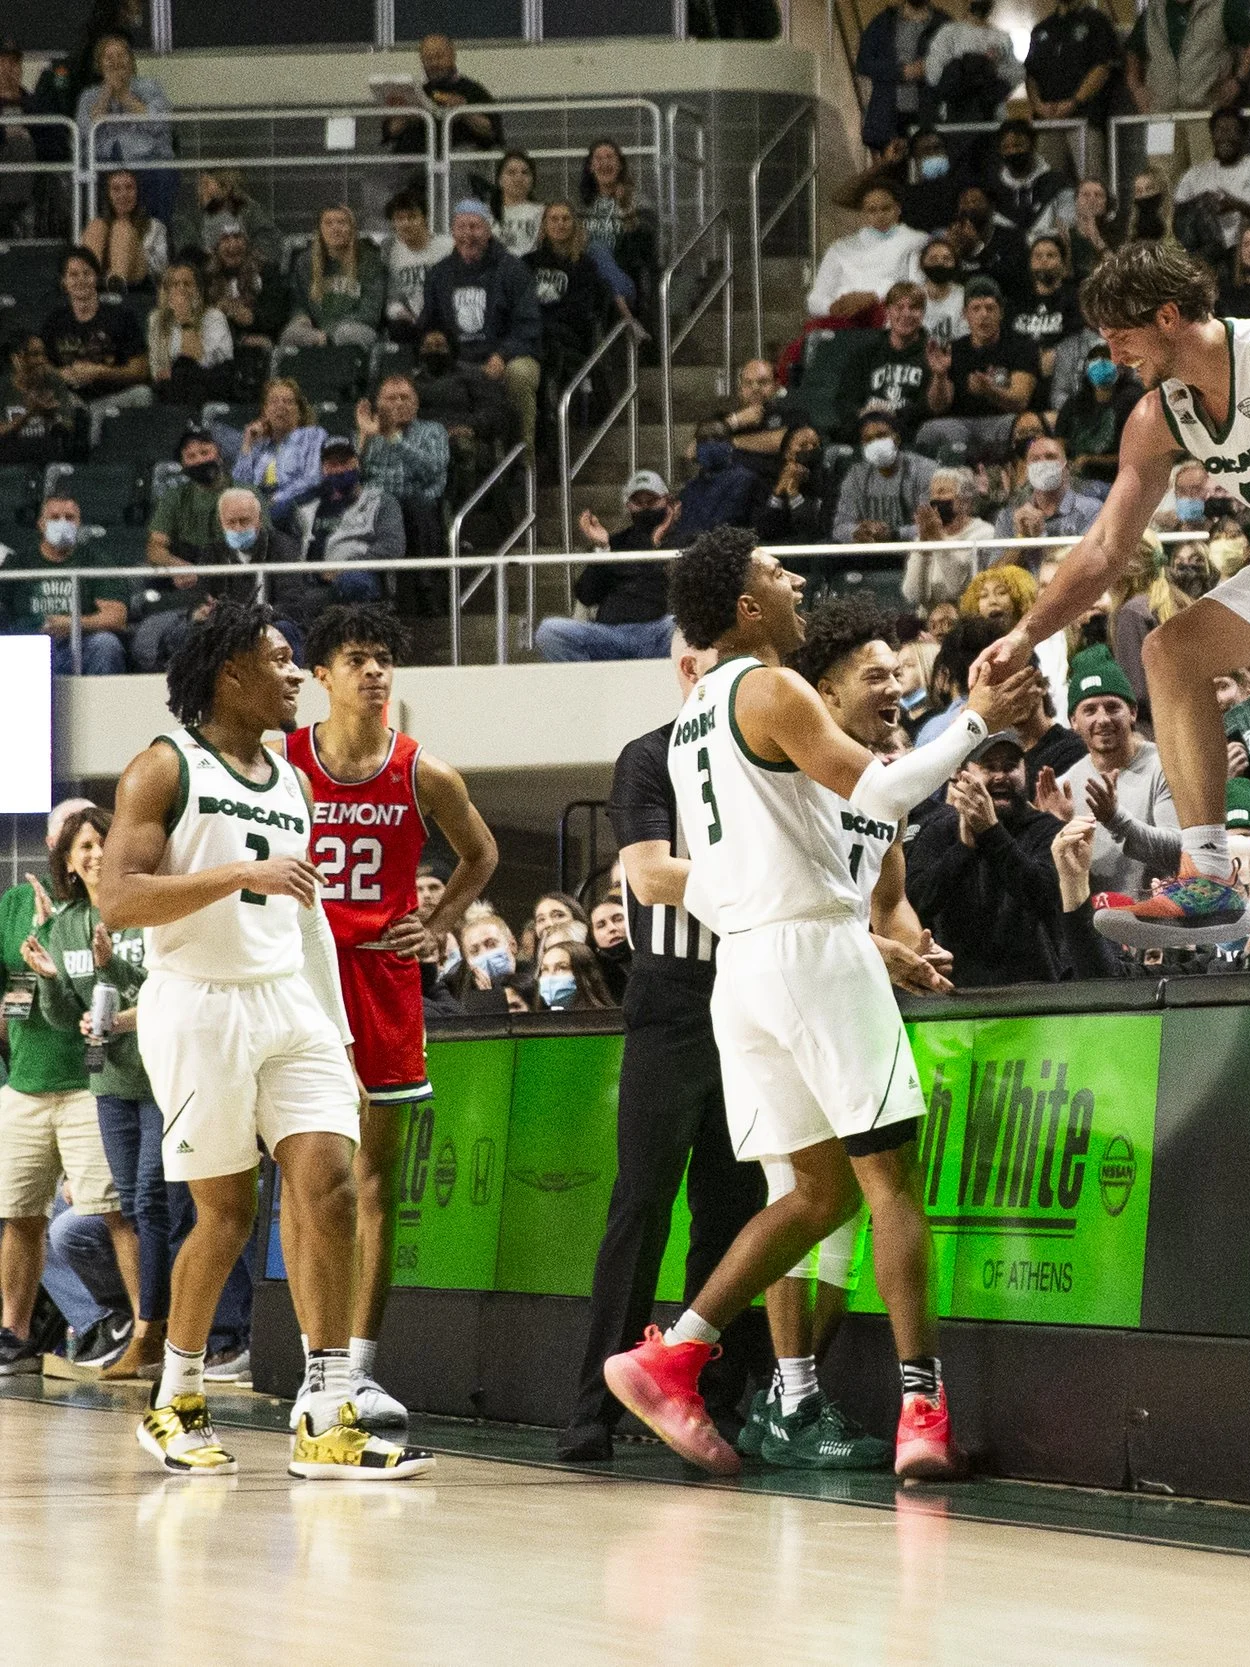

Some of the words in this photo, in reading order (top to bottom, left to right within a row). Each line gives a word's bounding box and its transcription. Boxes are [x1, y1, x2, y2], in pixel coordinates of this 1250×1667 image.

[198, 796, 304, 835] BOBCATS
[312, 802, 408, 826] ELMONT
[697, 747, 723, 846] 3
[314, 836, 384, 901] 22
[957, 1059, 1095, 1210] White
[982, 1257, 1003, 1289] OF
[1008, 1260, 1073, 1293] ATHENS
